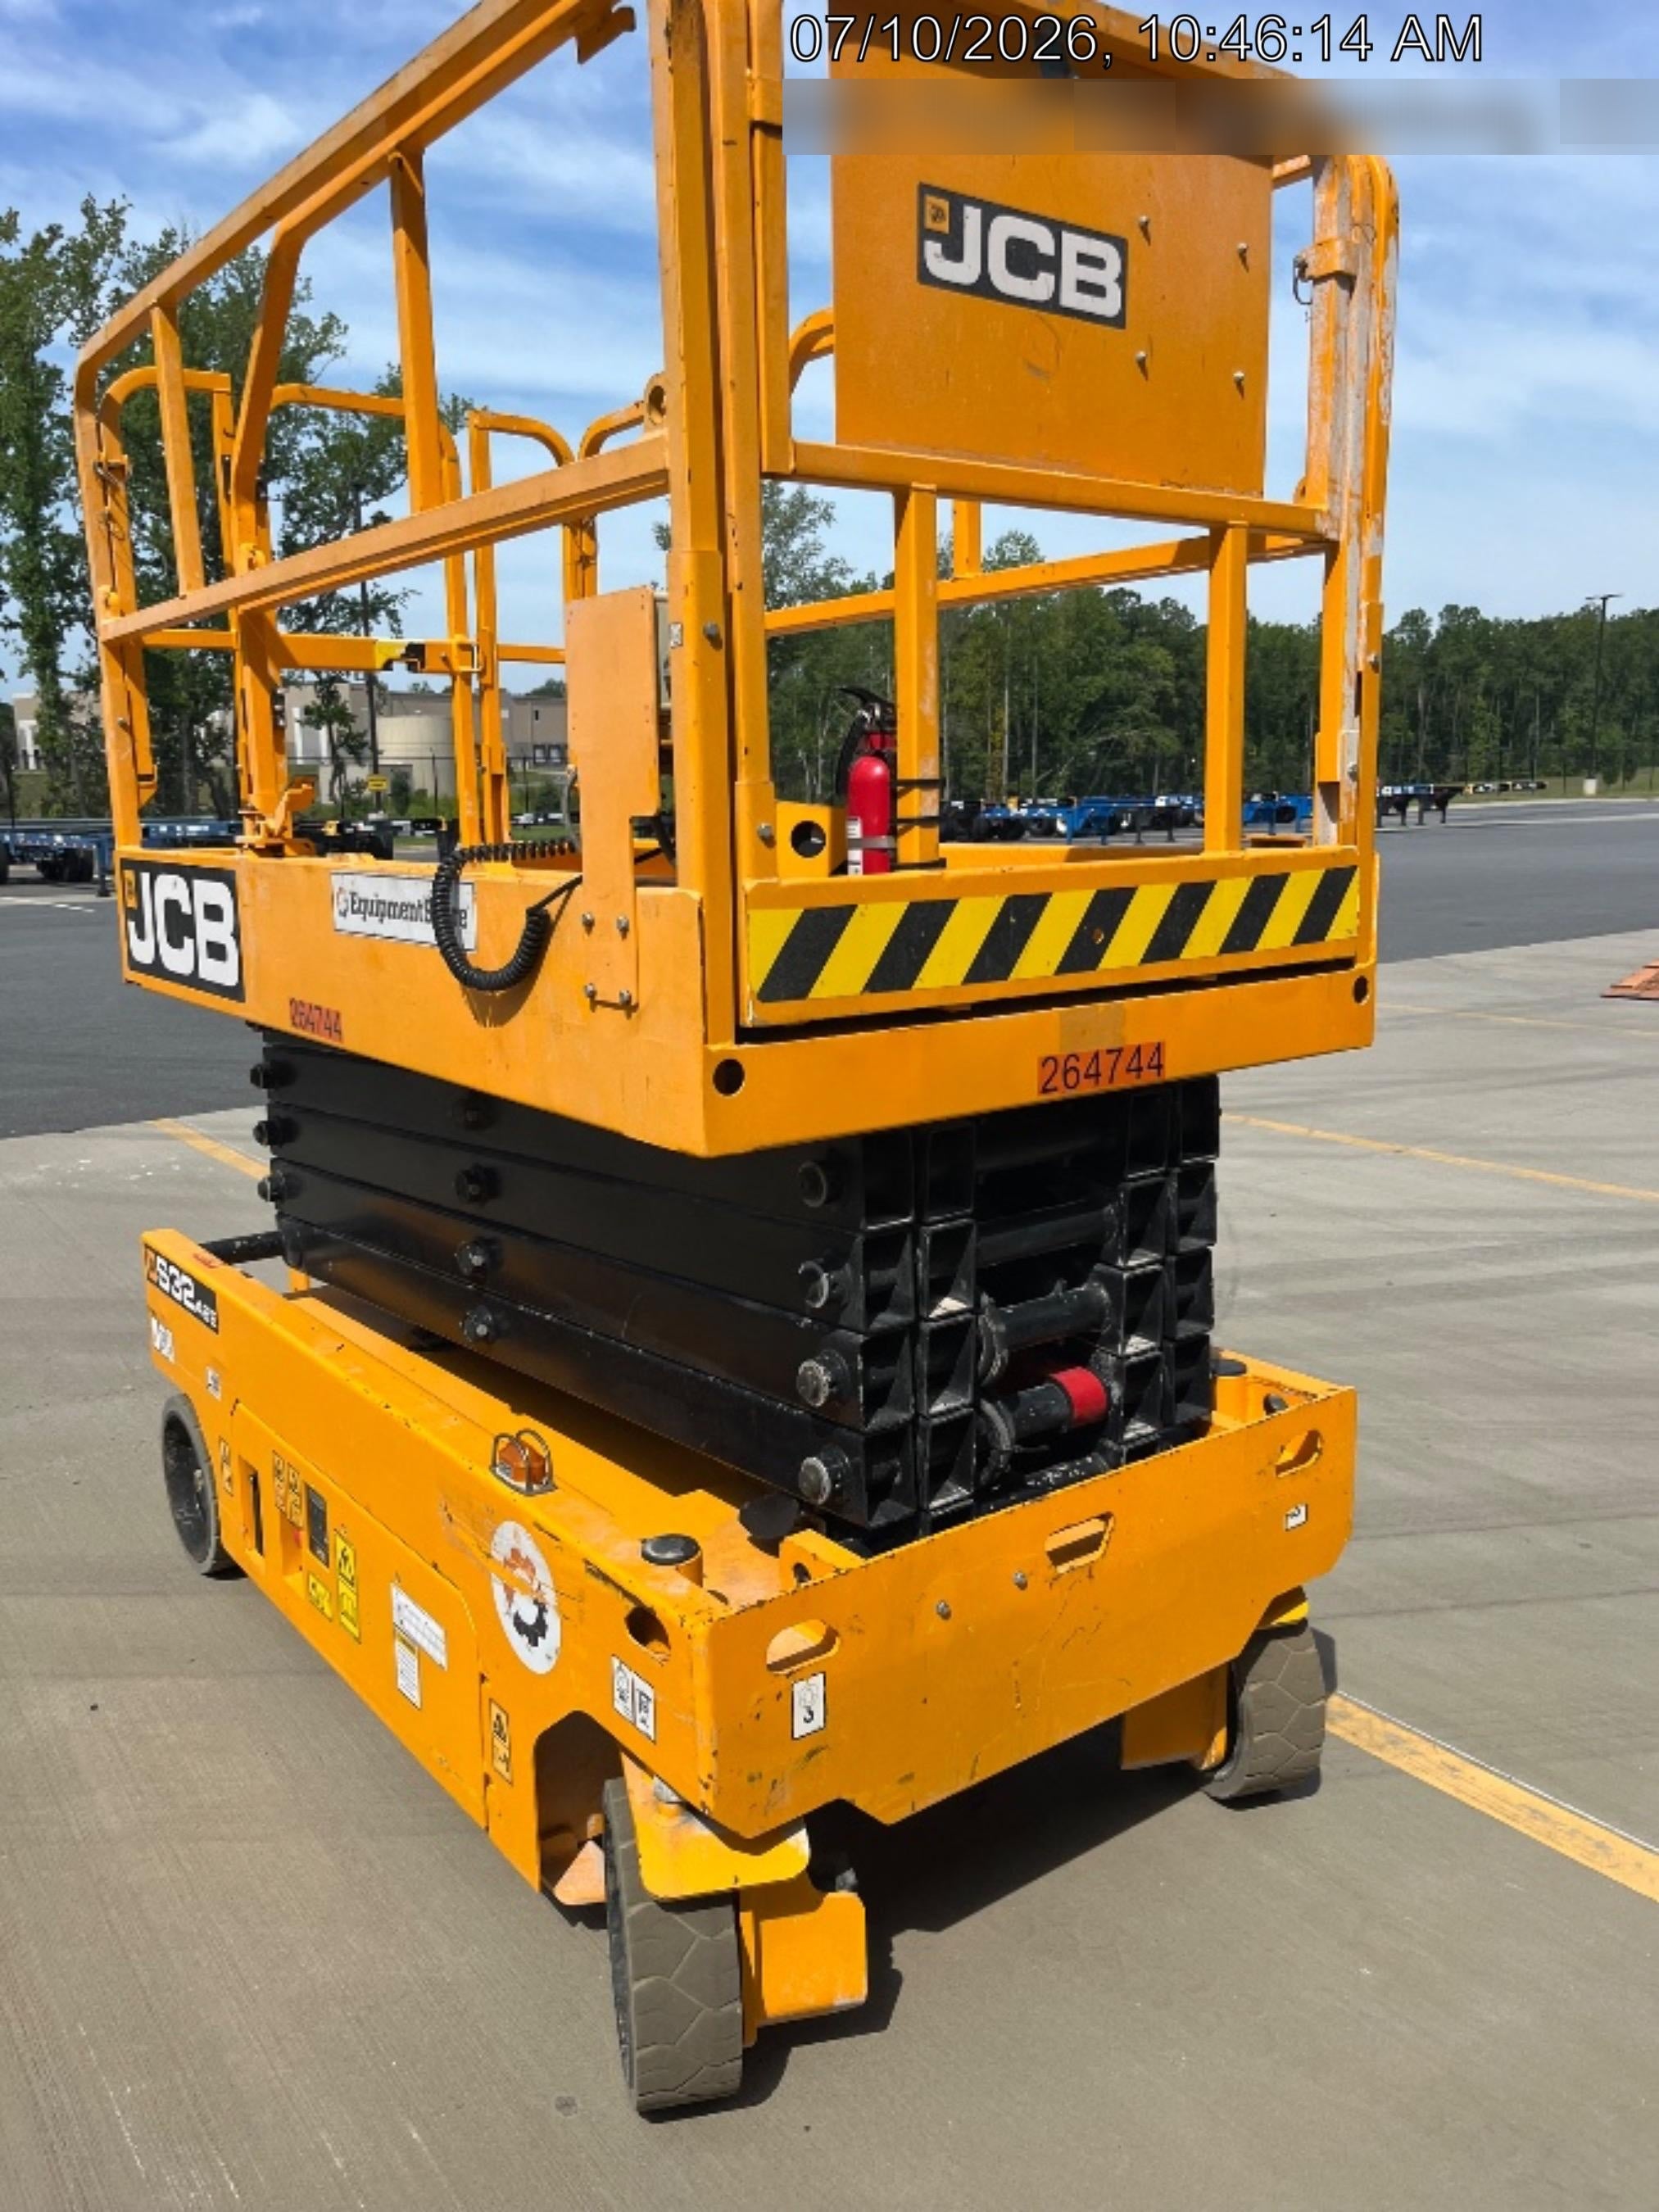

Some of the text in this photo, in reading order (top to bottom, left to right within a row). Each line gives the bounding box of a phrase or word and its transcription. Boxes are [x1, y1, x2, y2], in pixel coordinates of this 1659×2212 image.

[924, 205, 1122, 317] JCB
[127, 872, 238, 986] JCB
[1039, 1041, 1163, 1095] 264744
